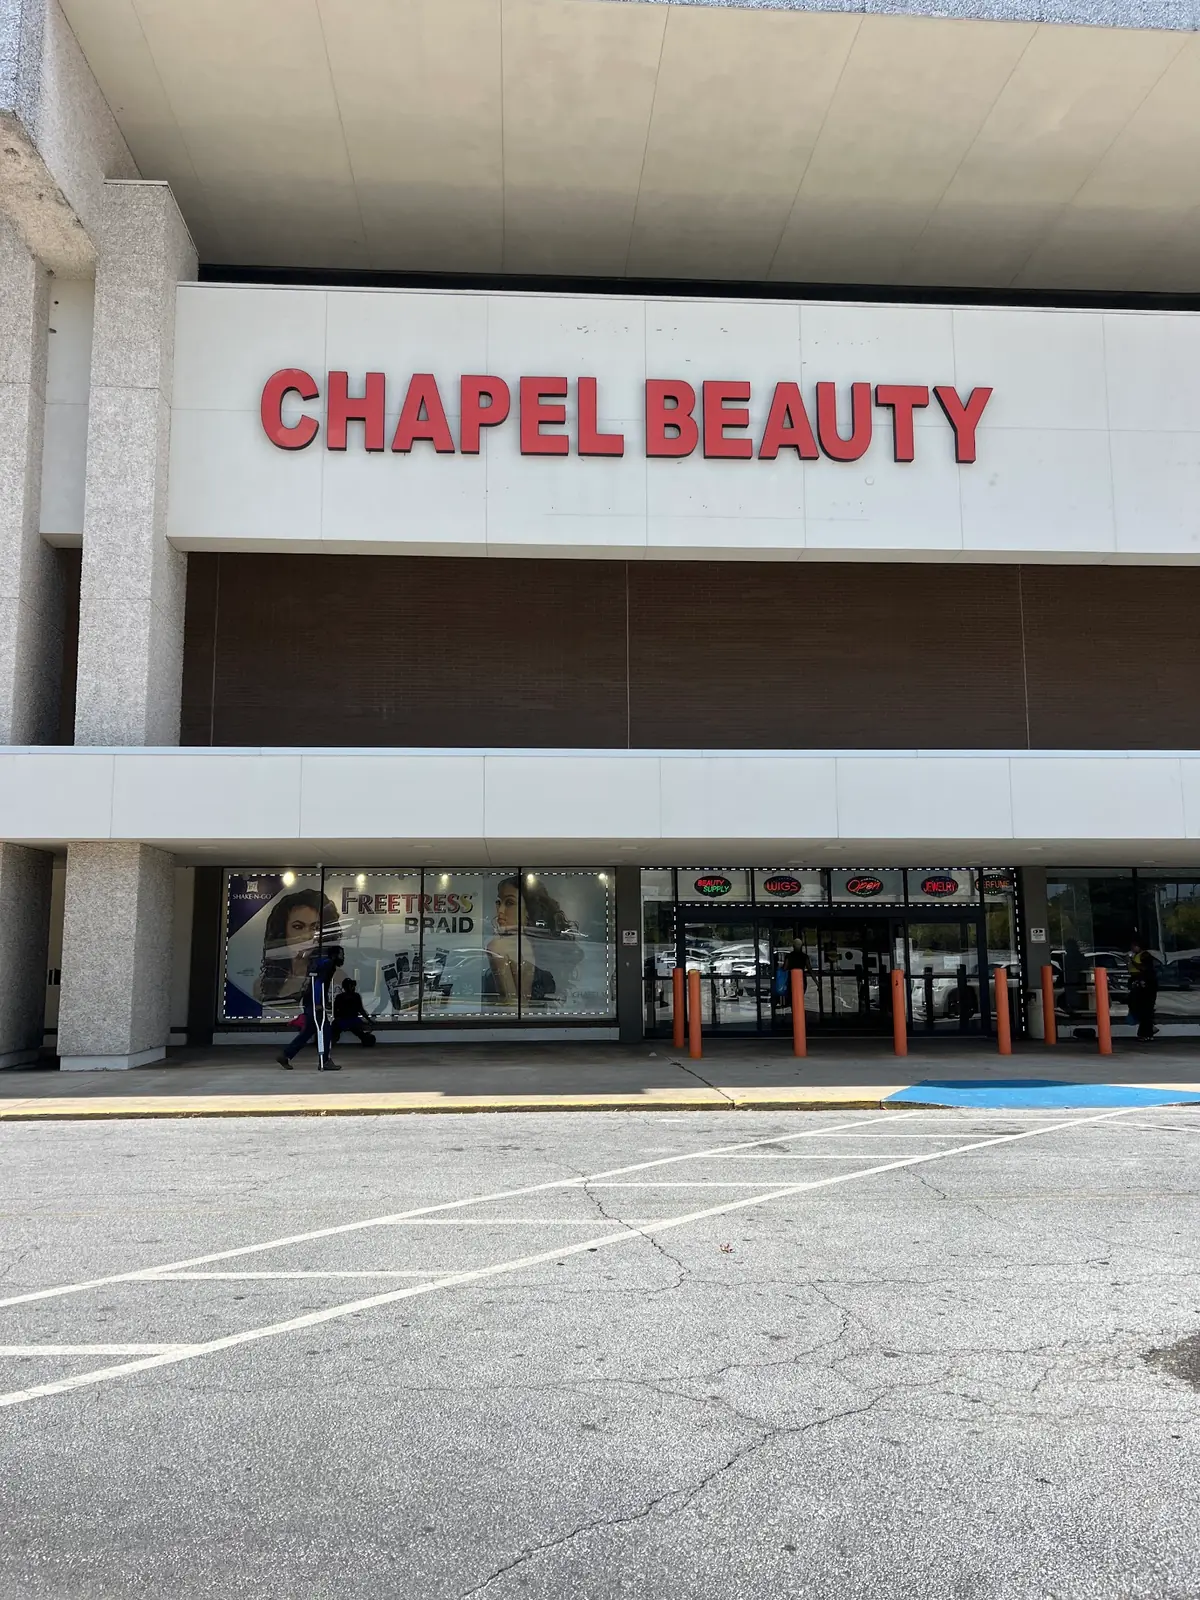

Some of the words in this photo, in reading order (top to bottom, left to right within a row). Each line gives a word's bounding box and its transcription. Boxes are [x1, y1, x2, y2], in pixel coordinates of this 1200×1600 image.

[261, 368, 624, 458] CHAPEL
[645, 379, 993, 465] BEAUTY
[697, 879, 725, 887] BEAUTY
[703, 885, 730, 893] SUPPLY
[766, 881, 799, 891] WIGS
[847, 880, 881, 893] Open
[923, 881, 957, 893] JEWELRY
[405, 916, 474, 934] BRAID
